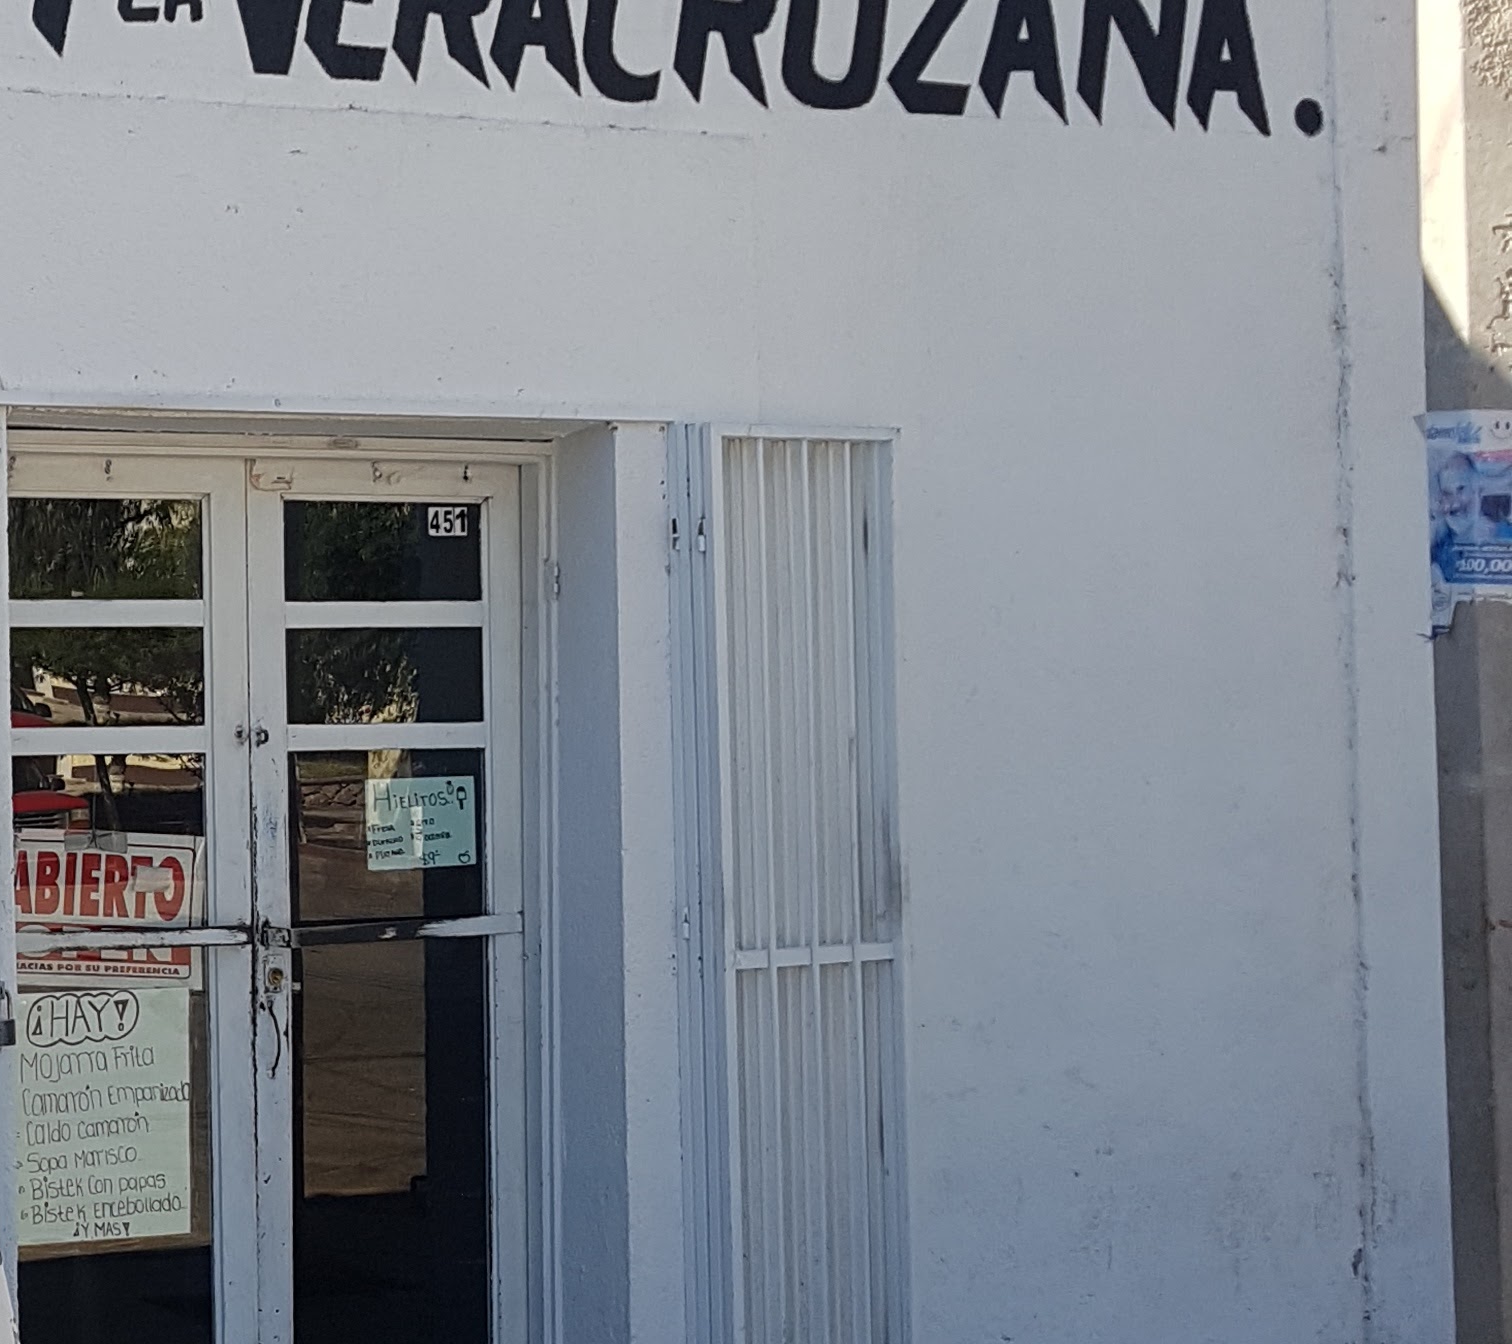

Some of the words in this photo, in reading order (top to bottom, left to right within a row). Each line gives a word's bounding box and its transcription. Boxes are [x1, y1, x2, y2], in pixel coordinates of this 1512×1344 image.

[430, 509, 466, 533] 451
[14, 850, 185, 921] ABIERTO
[17, 962, 53, 971] ACIAS
[58, 963, 81, 971] POR
[86, 964, 100, 972] SU
[105, 965, 180, 975] PREFERENCIA
[20, 1052, 108, 1083] Mojarra
[112, 1045, 154, 1068] Frita
[26, 1121, 71, 1146] Caldo
[27, 1152, 67, 1174] Sopa
[118, 1173, 166, 1196] papas
